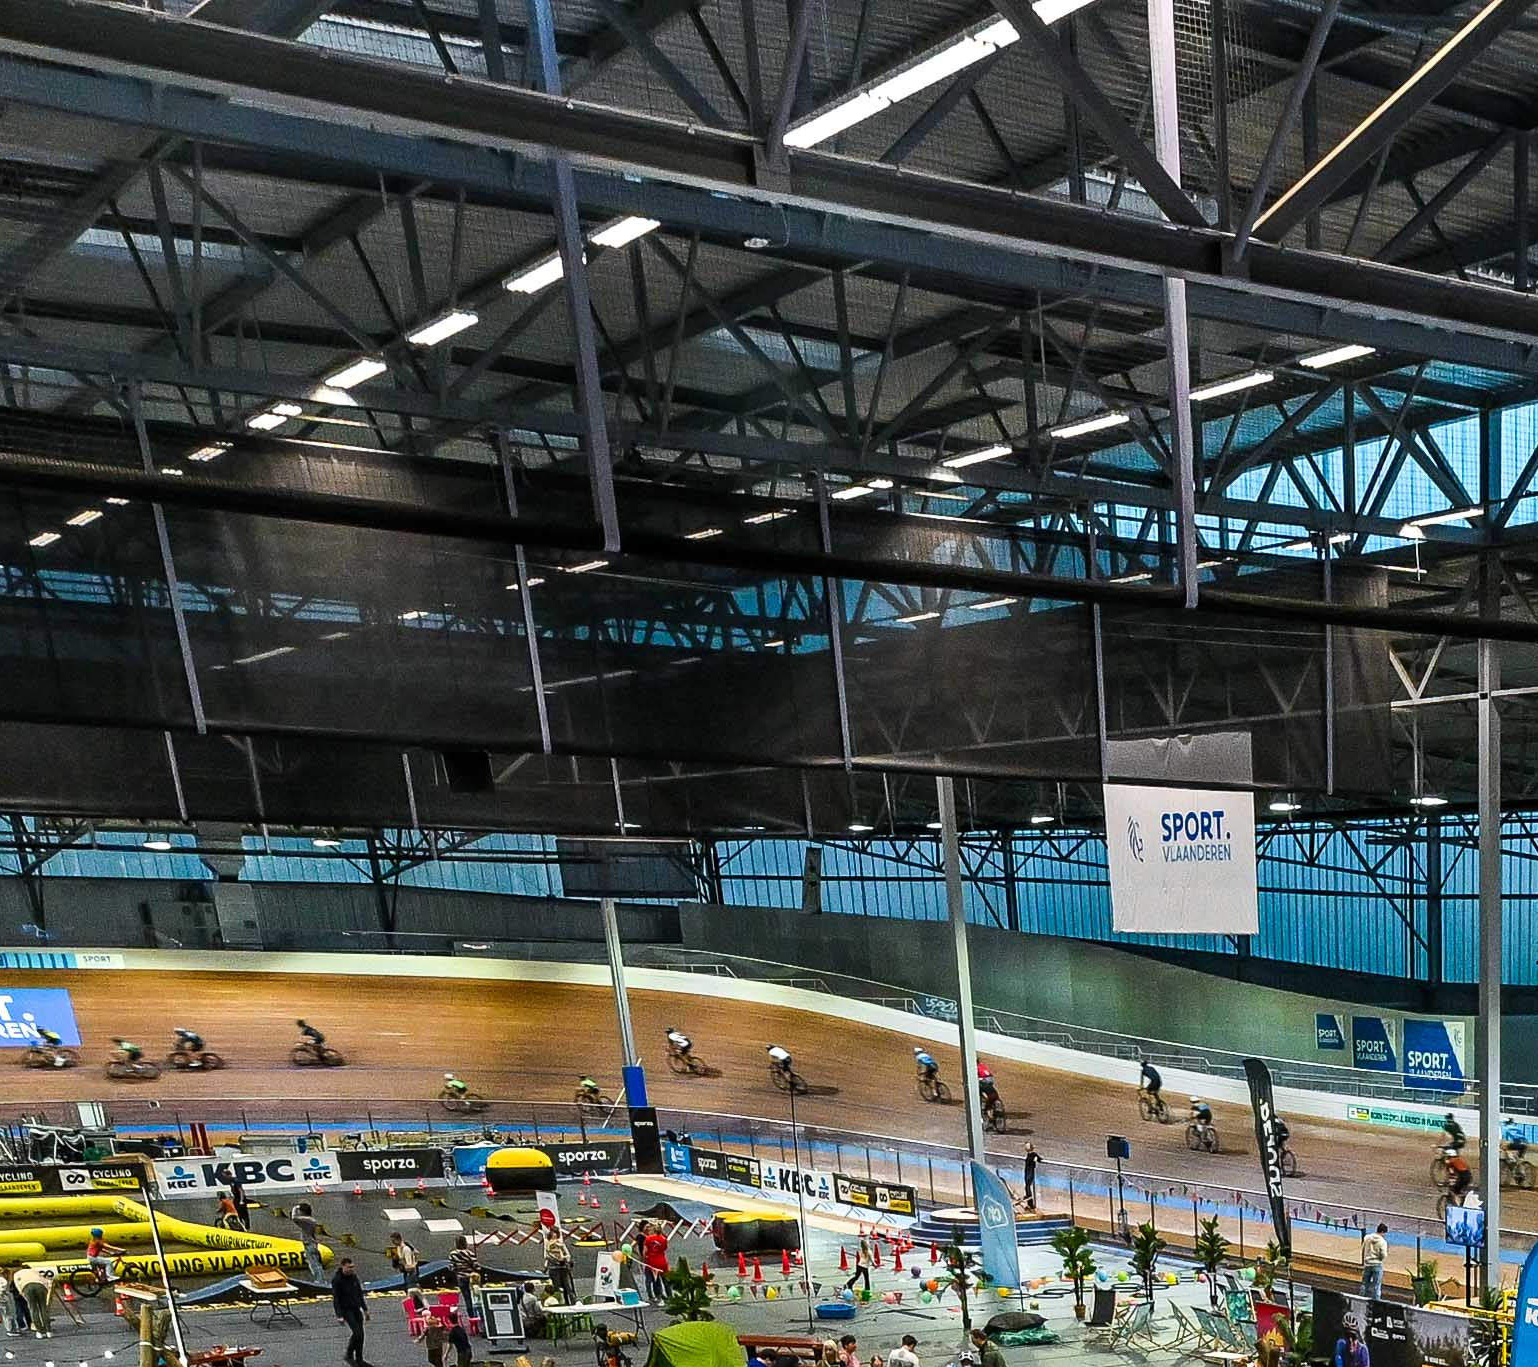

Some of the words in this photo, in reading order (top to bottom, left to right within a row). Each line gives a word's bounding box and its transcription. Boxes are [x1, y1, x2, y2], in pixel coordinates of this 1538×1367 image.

[1160, 810, 1231, 842] SPORT.
[1162, 843, 1231, 863] VLAANDEREN
[1355, 1039, 1388, 1053] SPORT.
[1407, 1050, 1452, 1071] SPORT.
[362, 1157, 420, 1174] sporza.
[557, 1149, 611, 1167] sporza.
[92, 1168, 133, 1180] CYCLING
[201, 1159, 296, 1187] KBC
[303, 1169, 333, 1181] KBC
[778, 1168, 816, 1197] KBC
[167, 1179, 198, 1190] KBC
[207, 1251, 309, 1272] VLAANDERE
